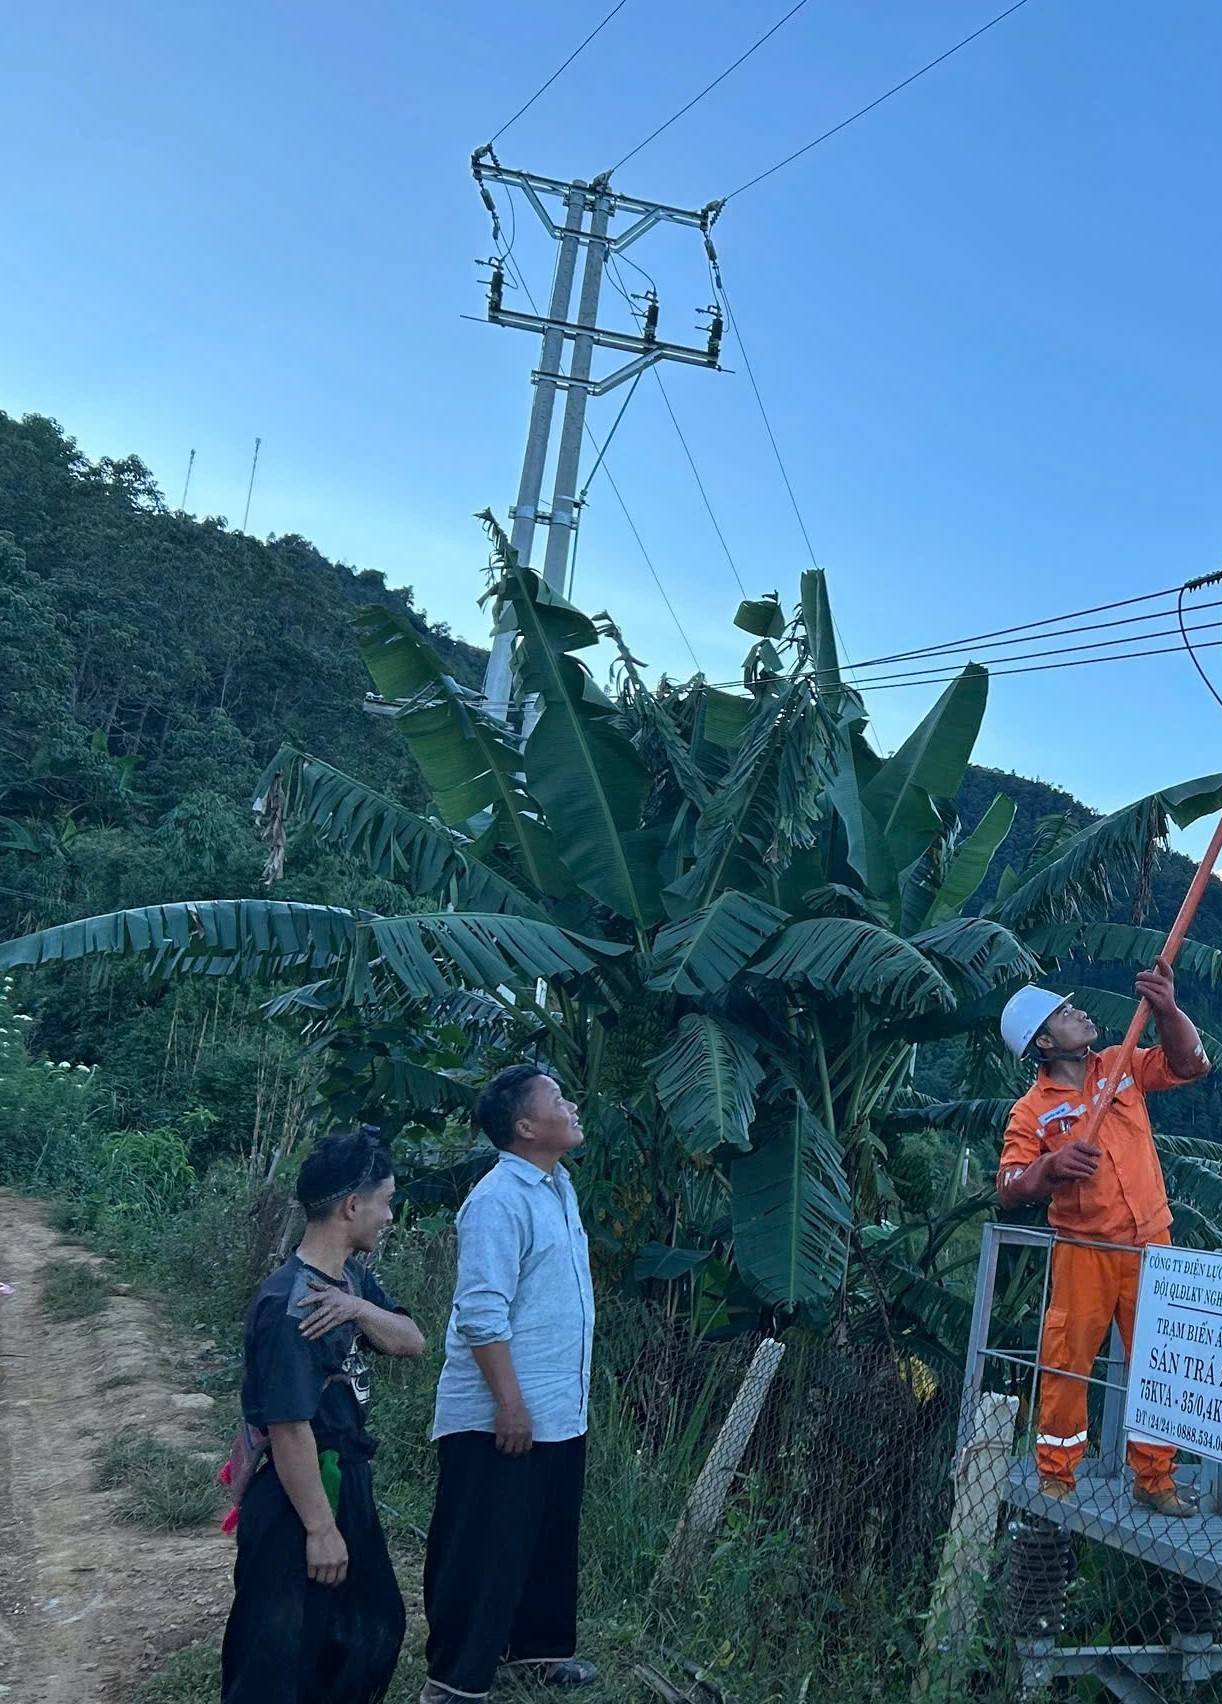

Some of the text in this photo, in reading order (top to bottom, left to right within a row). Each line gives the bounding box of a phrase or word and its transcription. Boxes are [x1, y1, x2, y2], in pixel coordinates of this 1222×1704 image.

[1149, 1253, 1171, 1271] CÔNG
[1173, 1259, 1183, 1273] TY
[1184, 1258, 1205, 1279] ĐIỆN
[1154, 1276, 1168, 1298] ĐỘI
[1157, 1318, 1185, 1341] TRẠM
[1186, 1321, 1214, 1346] BIẾN
[1149, 1343, 1181, 1375] SÁN
[1184, 1354, 1215, 1386] TRÁ
[1140, 1378, 1172, 1408] 75KVA
[1136, 1408, 1147, 1425] ĐT
